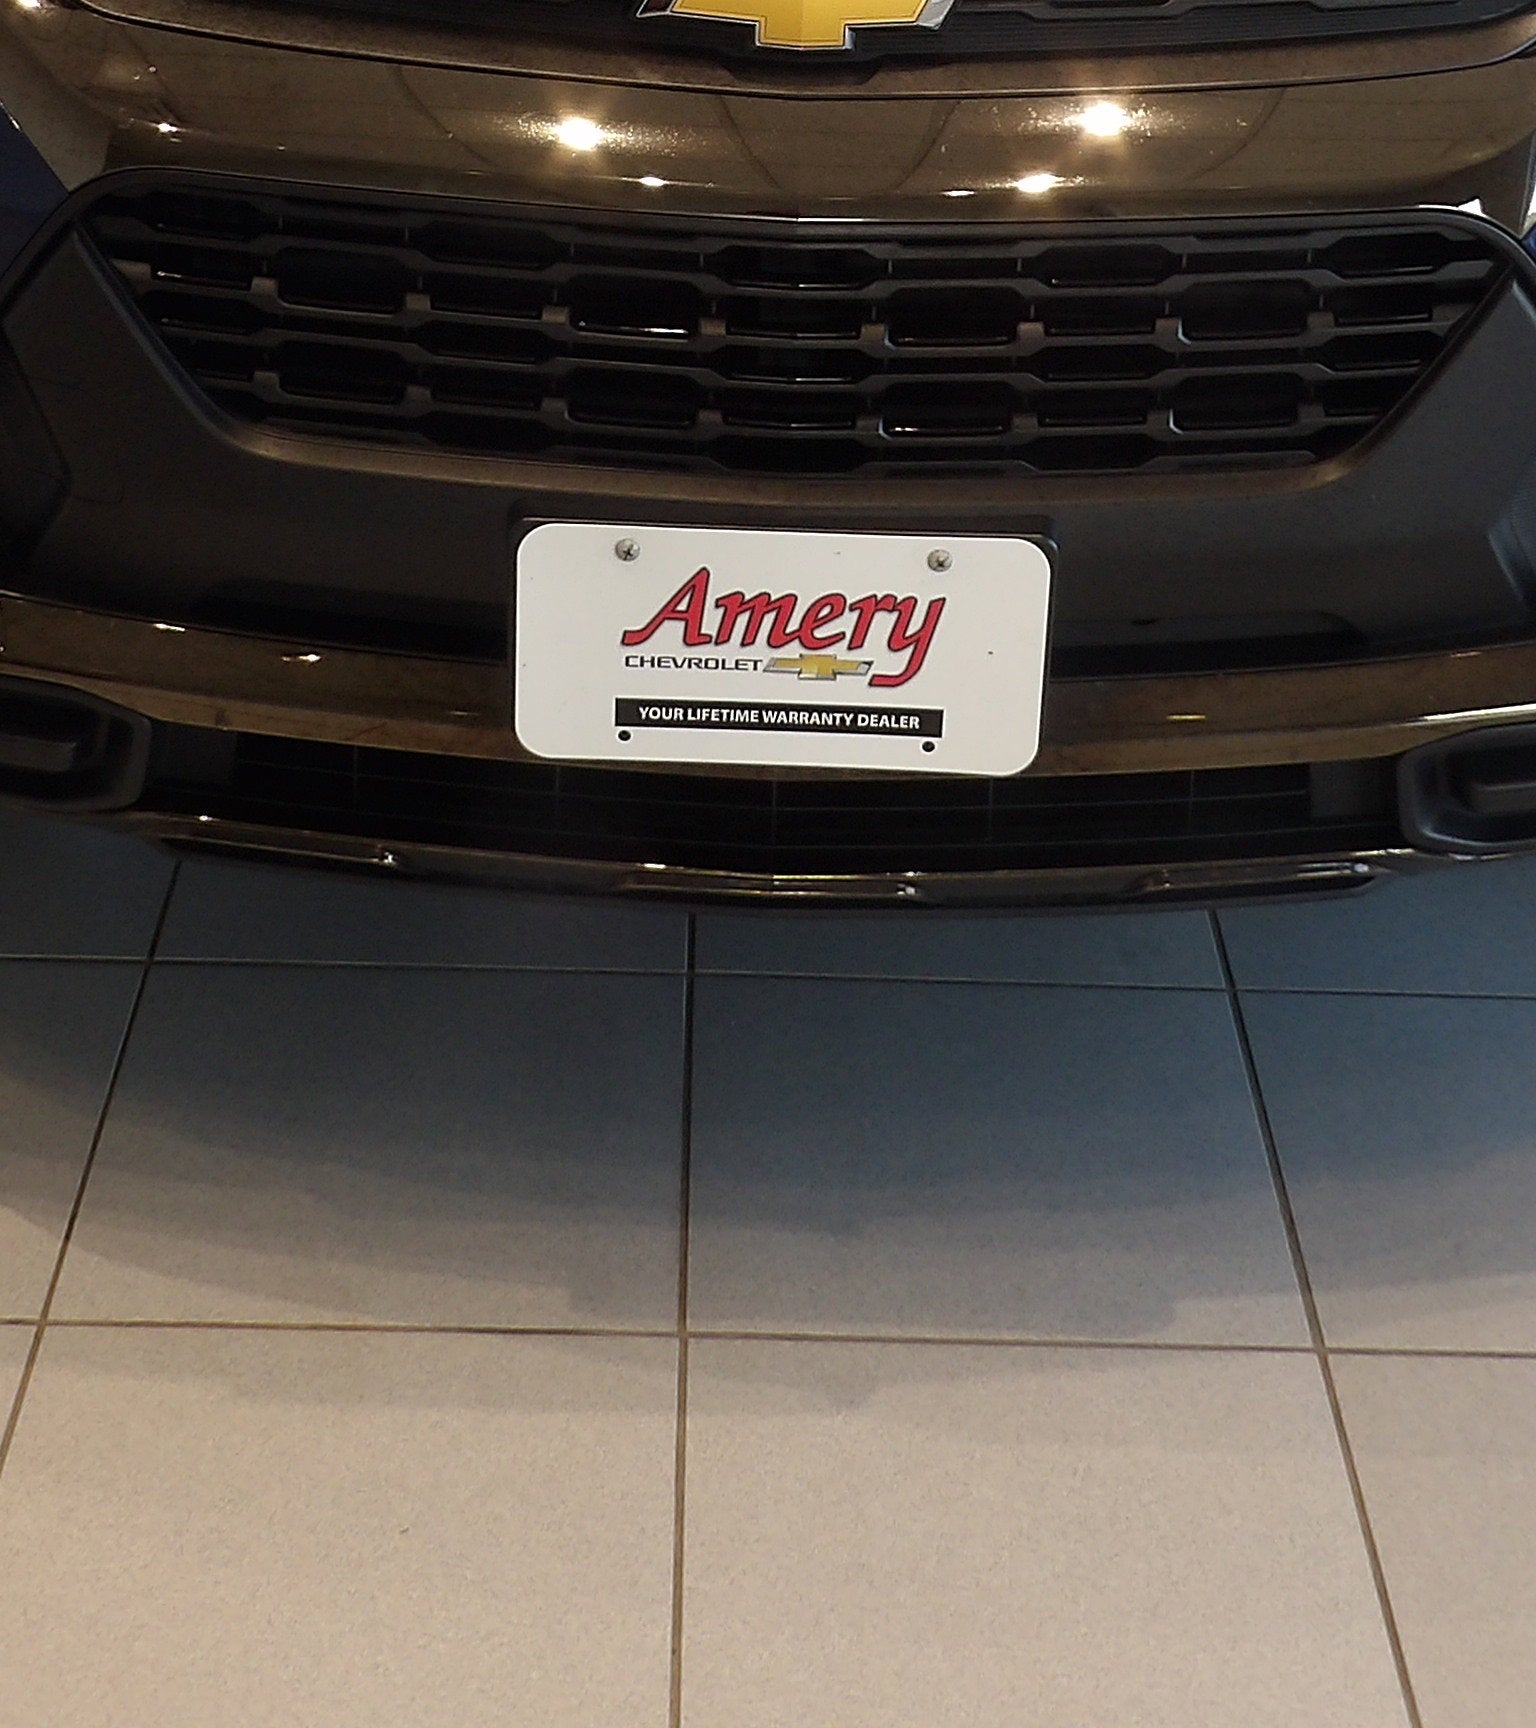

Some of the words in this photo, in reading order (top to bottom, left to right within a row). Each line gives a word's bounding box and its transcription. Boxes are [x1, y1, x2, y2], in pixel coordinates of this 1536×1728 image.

[621, 566, 946, 687] Amery
[624, 655, 763, 672] CHEVROLET
[638, 706, 684, 721] YOUR
[687, 708, 760, 723] LIFETIME
[762, 710, 855, 727] WARRANTY
[857, 714, 921, 730] DEALER
